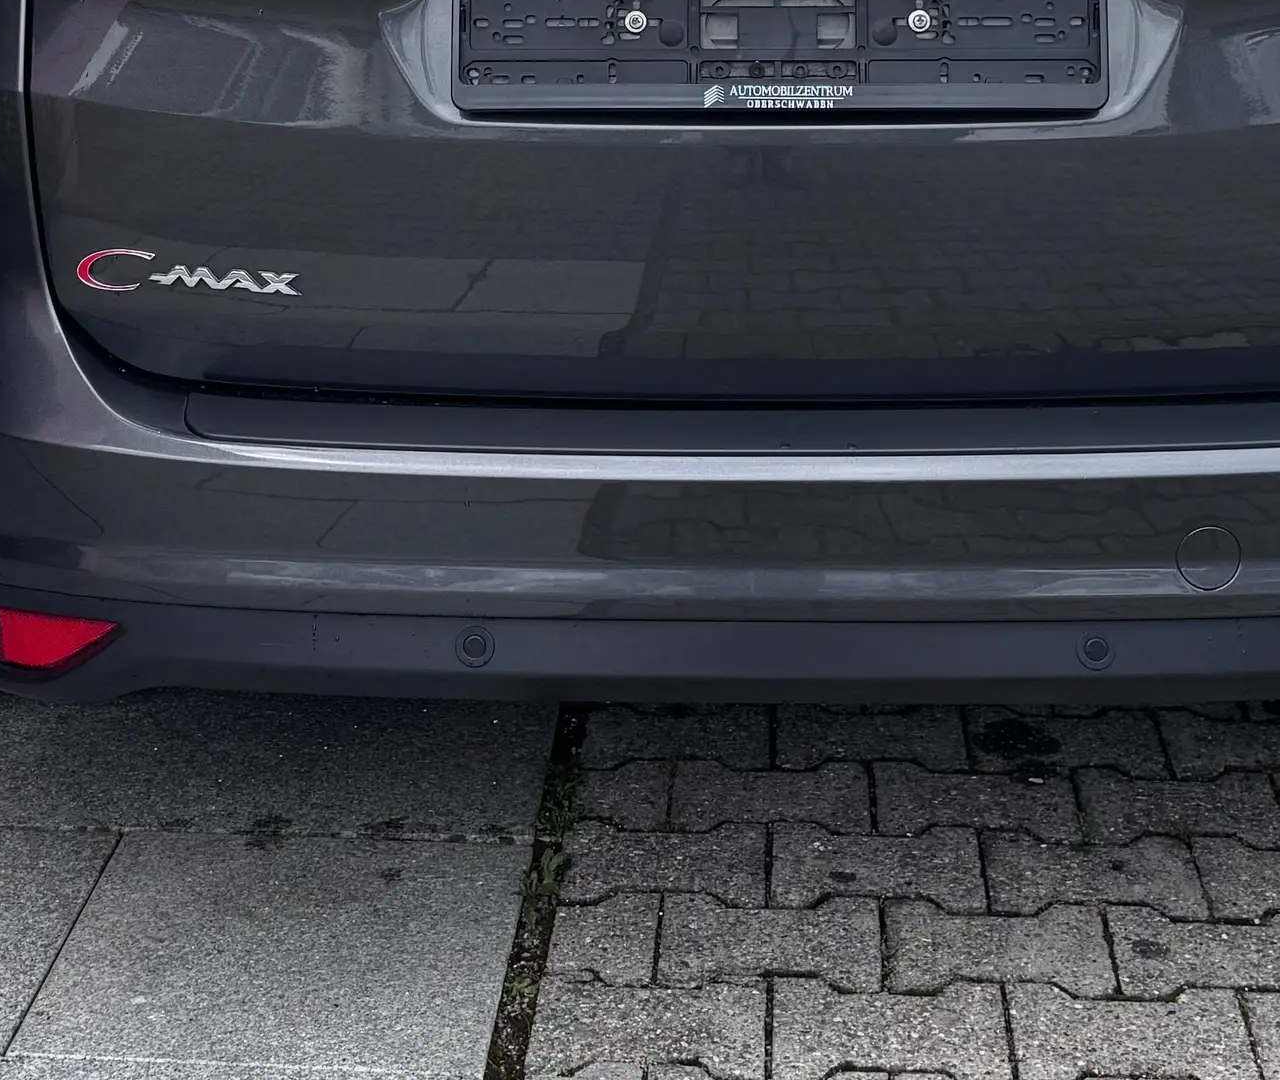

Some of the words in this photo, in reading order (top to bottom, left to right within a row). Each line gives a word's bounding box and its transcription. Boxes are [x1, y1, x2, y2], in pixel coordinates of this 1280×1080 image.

[729, 84, 854, 97] AUTOMOBILZENTRUM
[746, 99, 834, 109] OBERSCHWABEN
[76, 248, 303, 296] C-MAX
